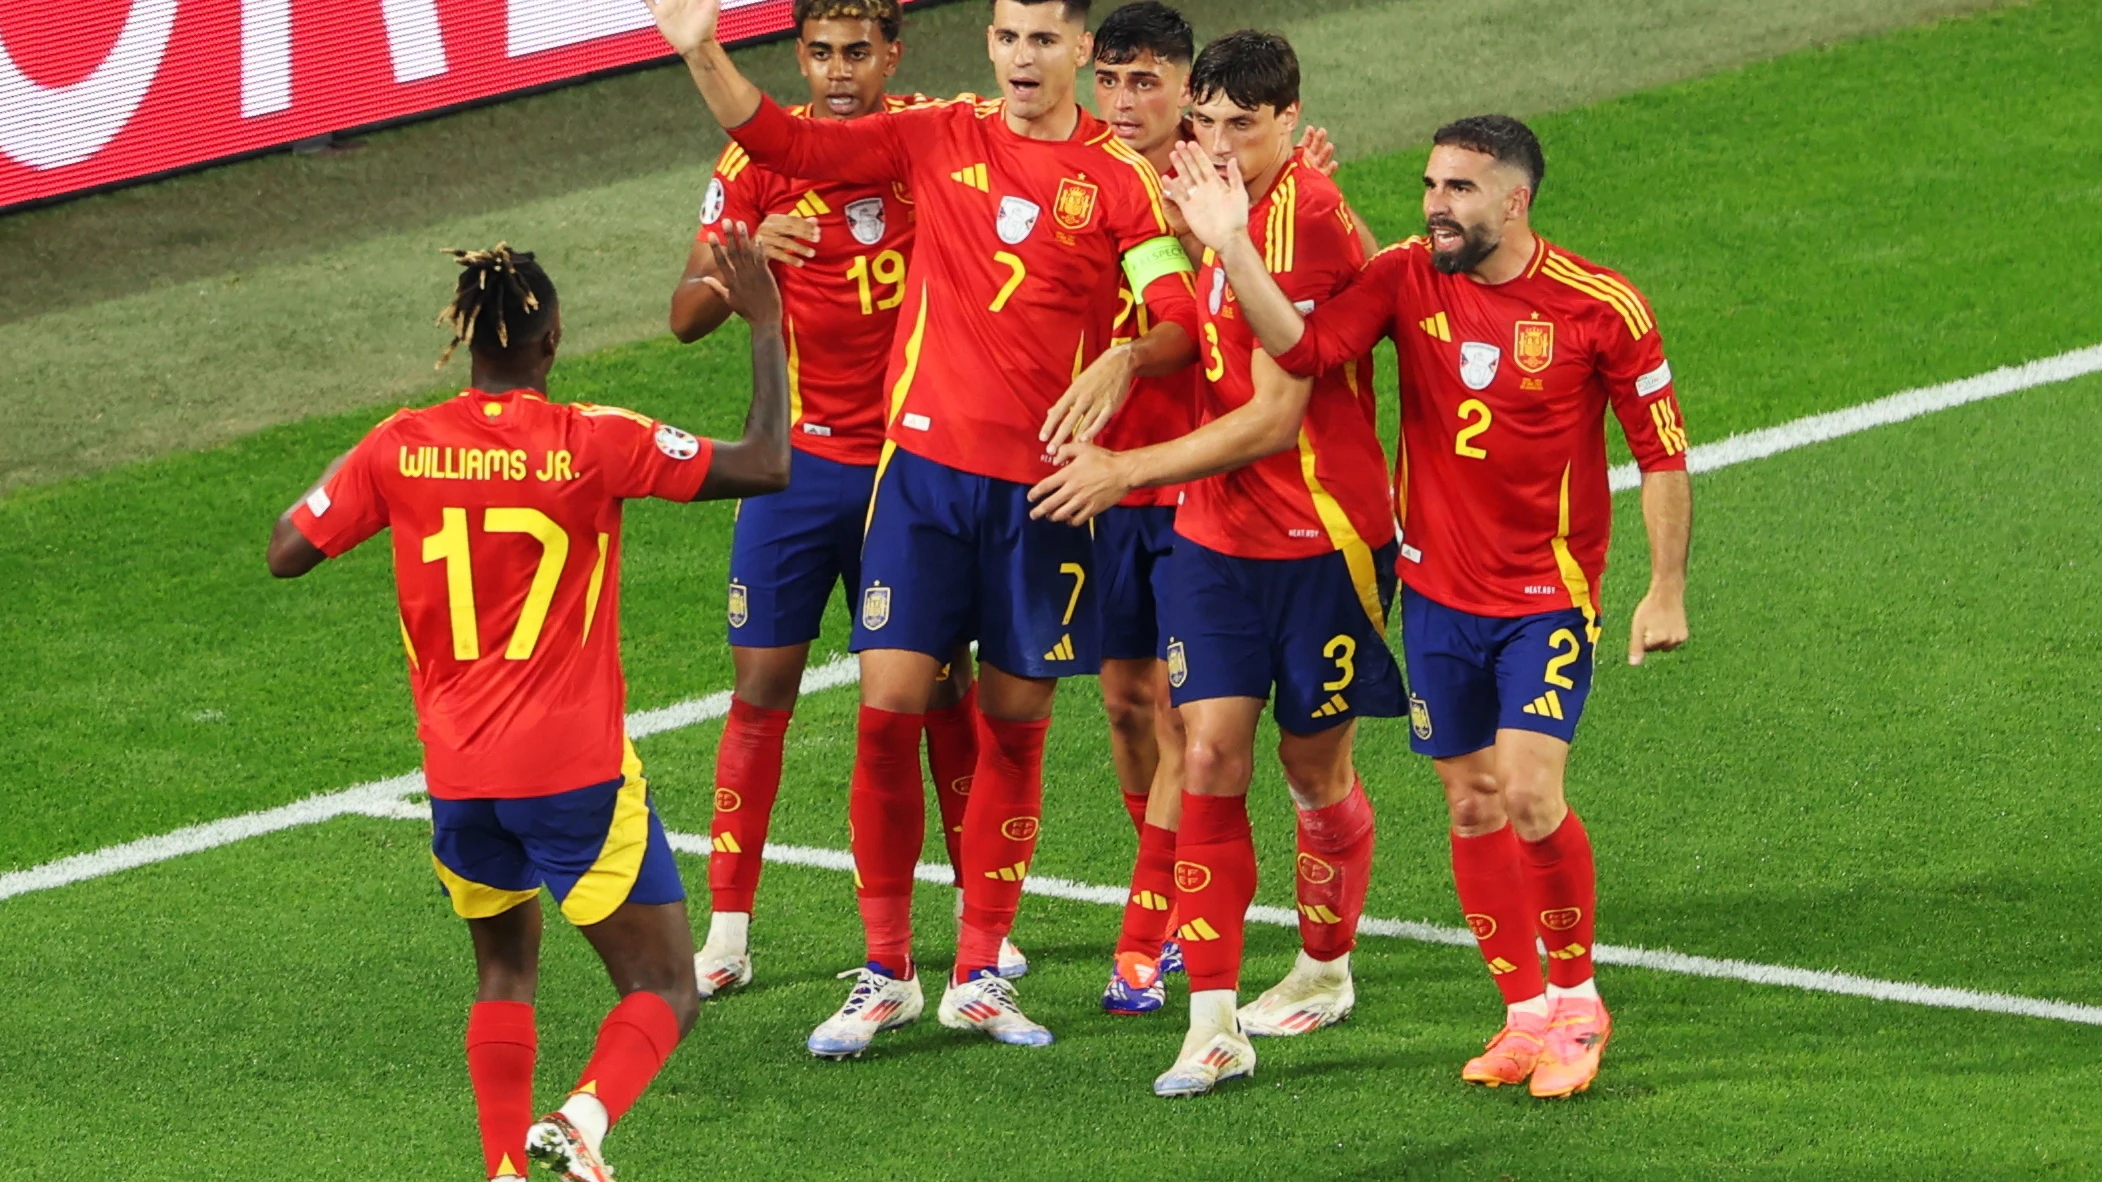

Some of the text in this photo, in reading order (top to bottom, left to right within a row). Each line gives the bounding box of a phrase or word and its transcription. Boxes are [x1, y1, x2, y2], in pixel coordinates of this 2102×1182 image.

[846, 249, 906, 315] 19
[990, 251, 1027, 313] 7
[1203, 322, 1225, 383] 3
[1455, 398, 1493, 460] 2
[399, 445, 581, 482] WILLIAMS JR.
[421, 506, 570, 661] 17
[1059, 562, 1086, 626] 7
[1322, 633, 1358, 693] 3
[1543, 627, 1581, 692] 2
